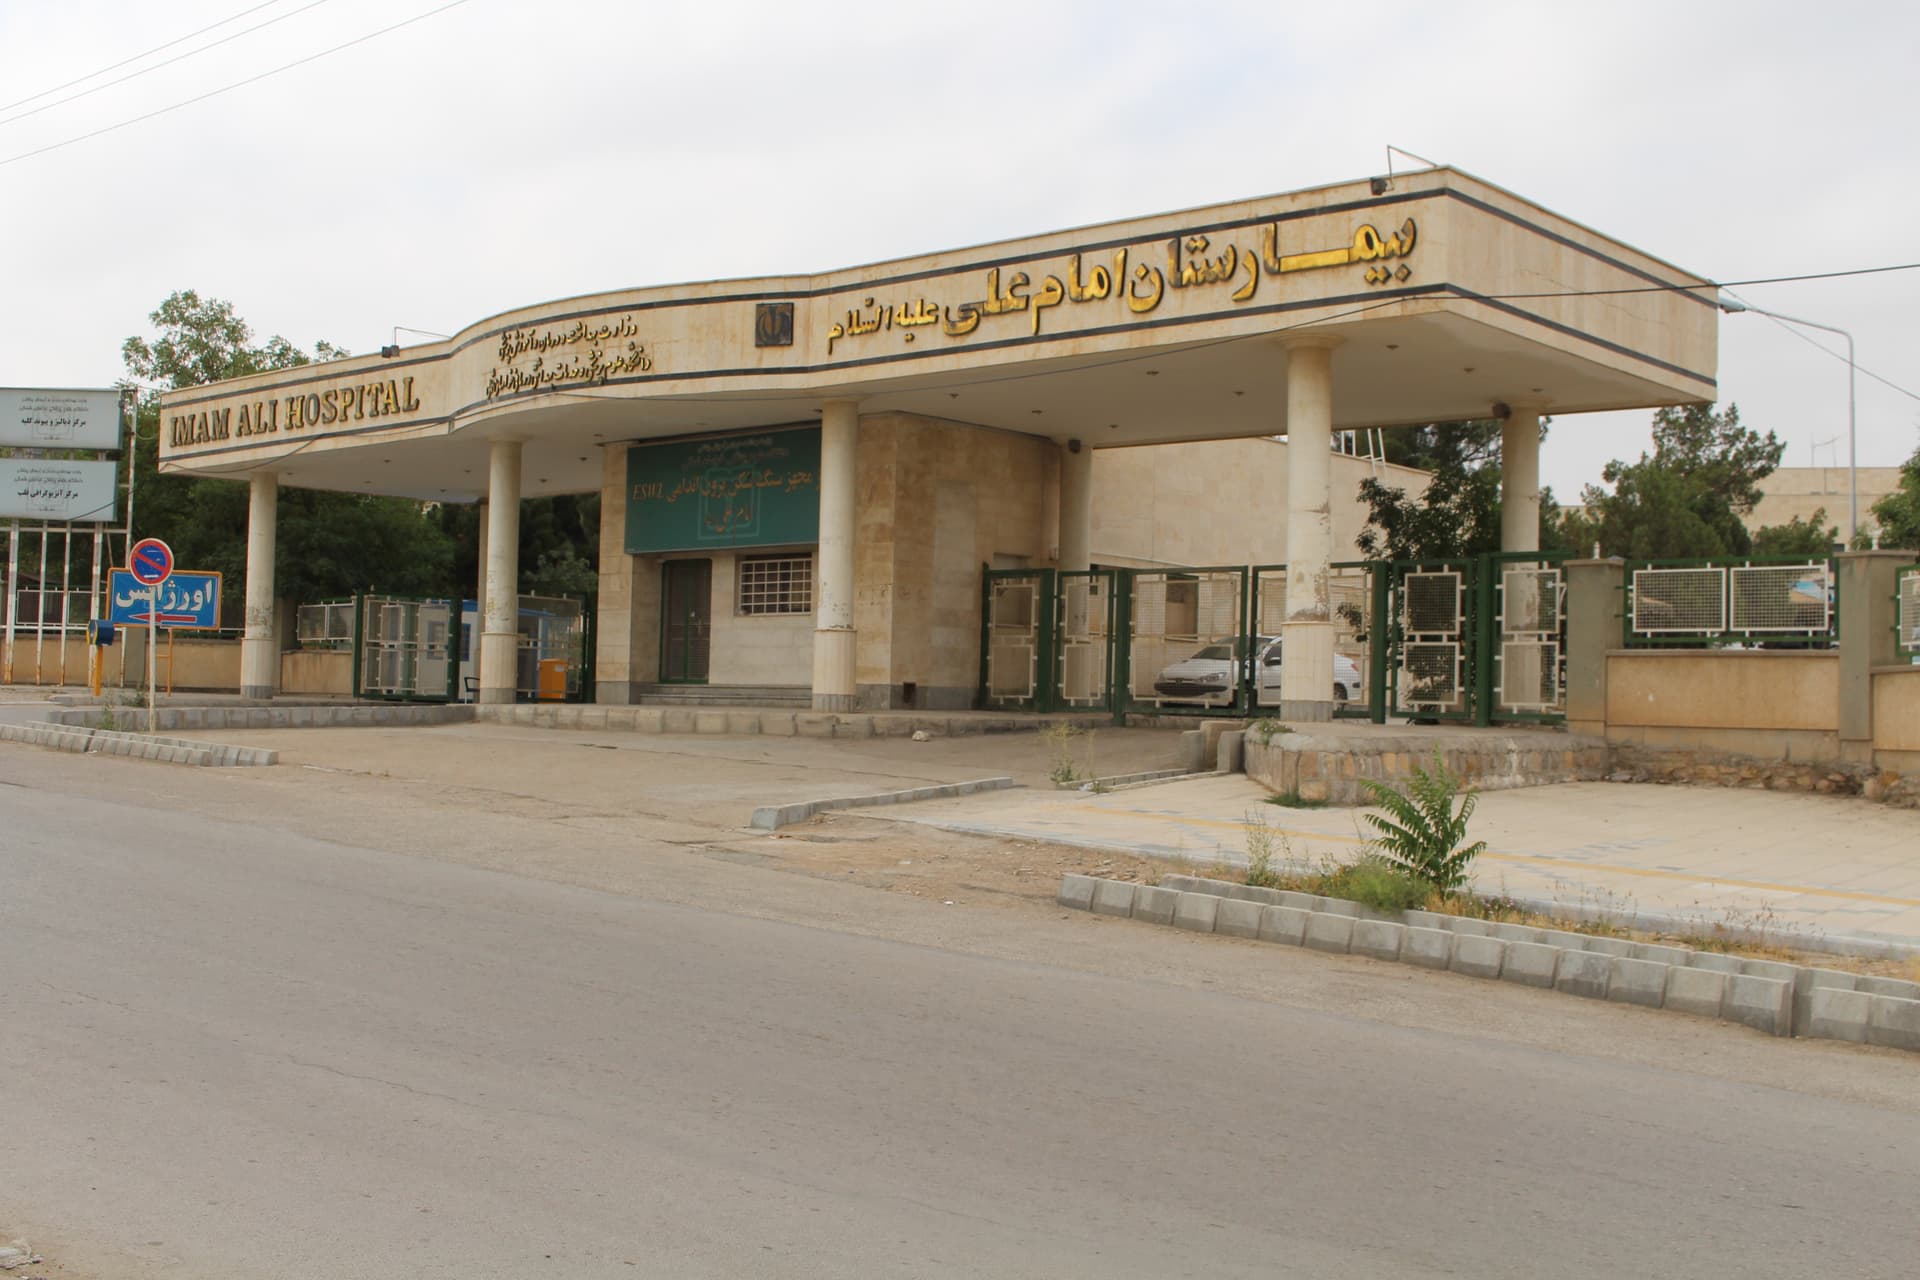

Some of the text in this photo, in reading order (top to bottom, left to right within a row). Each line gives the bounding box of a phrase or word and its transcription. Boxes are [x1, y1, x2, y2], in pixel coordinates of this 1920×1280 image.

[1126, 217, 1417, 314] بیمارستان
[943, 267, 1030, 337] علی
[1031, 247, 1128, 336] امام
[566, 321, 598, 346] بهداشت
[599, 314, 638, 340] وزارت
[623, 341, 652, 373] دانشگاه
[72, 418, 86, 428] مرکز
[169, 376, 419, 447] IMAM ALI HOSPITAL
[64, 490, 79, 499] مرکز
